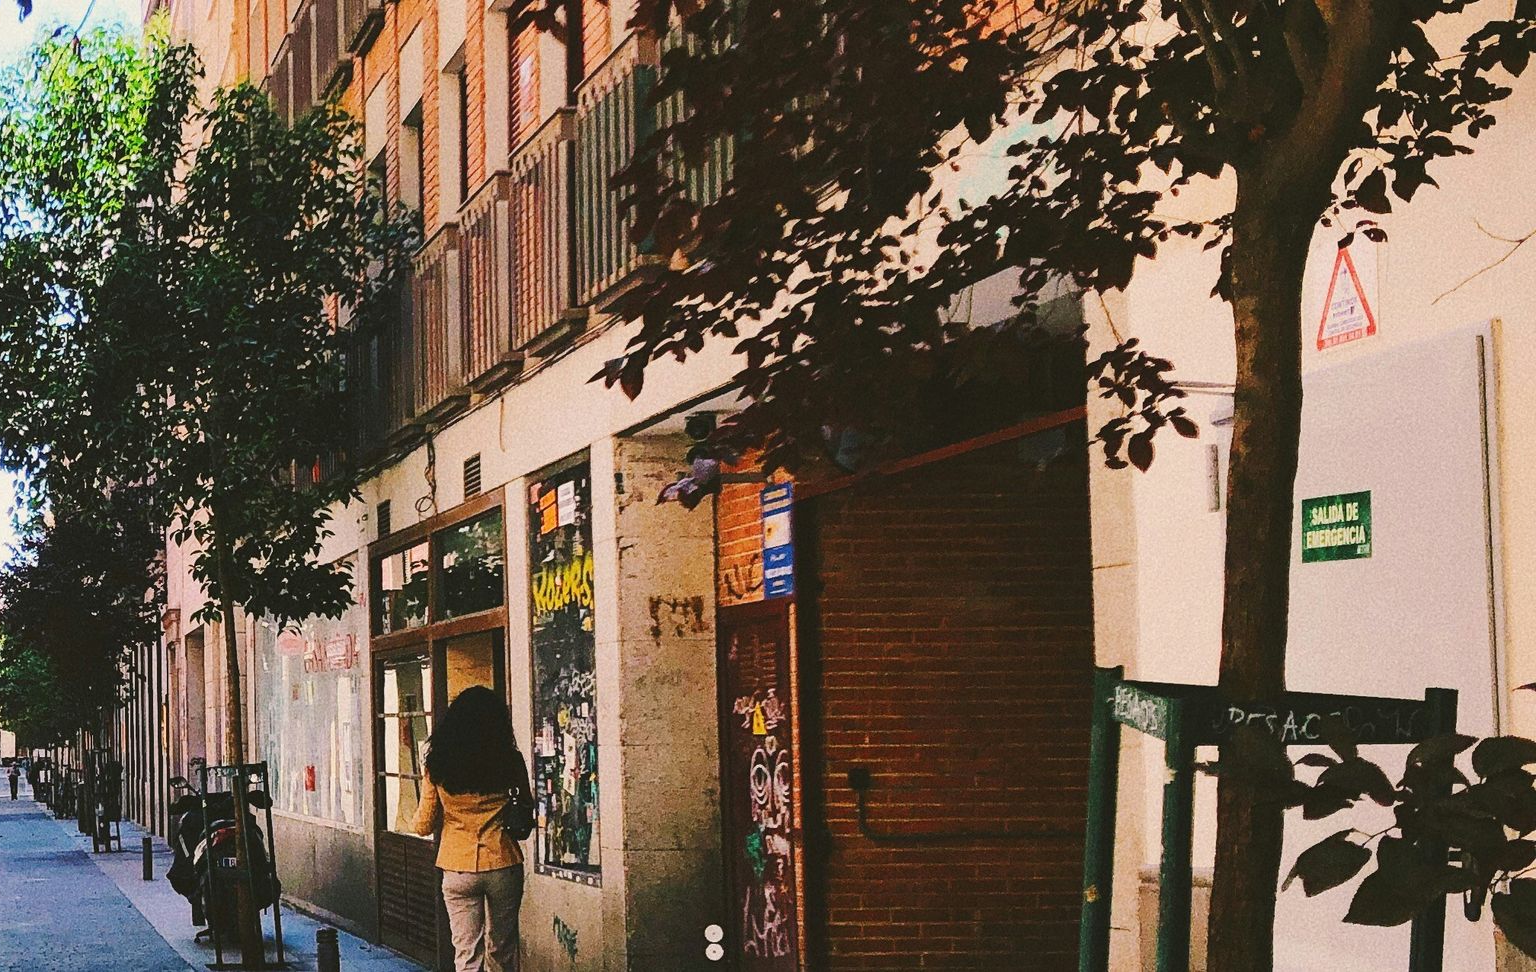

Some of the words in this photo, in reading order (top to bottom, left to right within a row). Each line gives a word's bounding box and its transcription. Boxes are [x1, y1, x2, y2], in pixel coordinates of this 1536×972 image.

[1311, 503, 1344, 526] SALIDA
[1345, 502, 1359, 522] DE
[1306, 523, 1366, 549] EMERGENCIA
